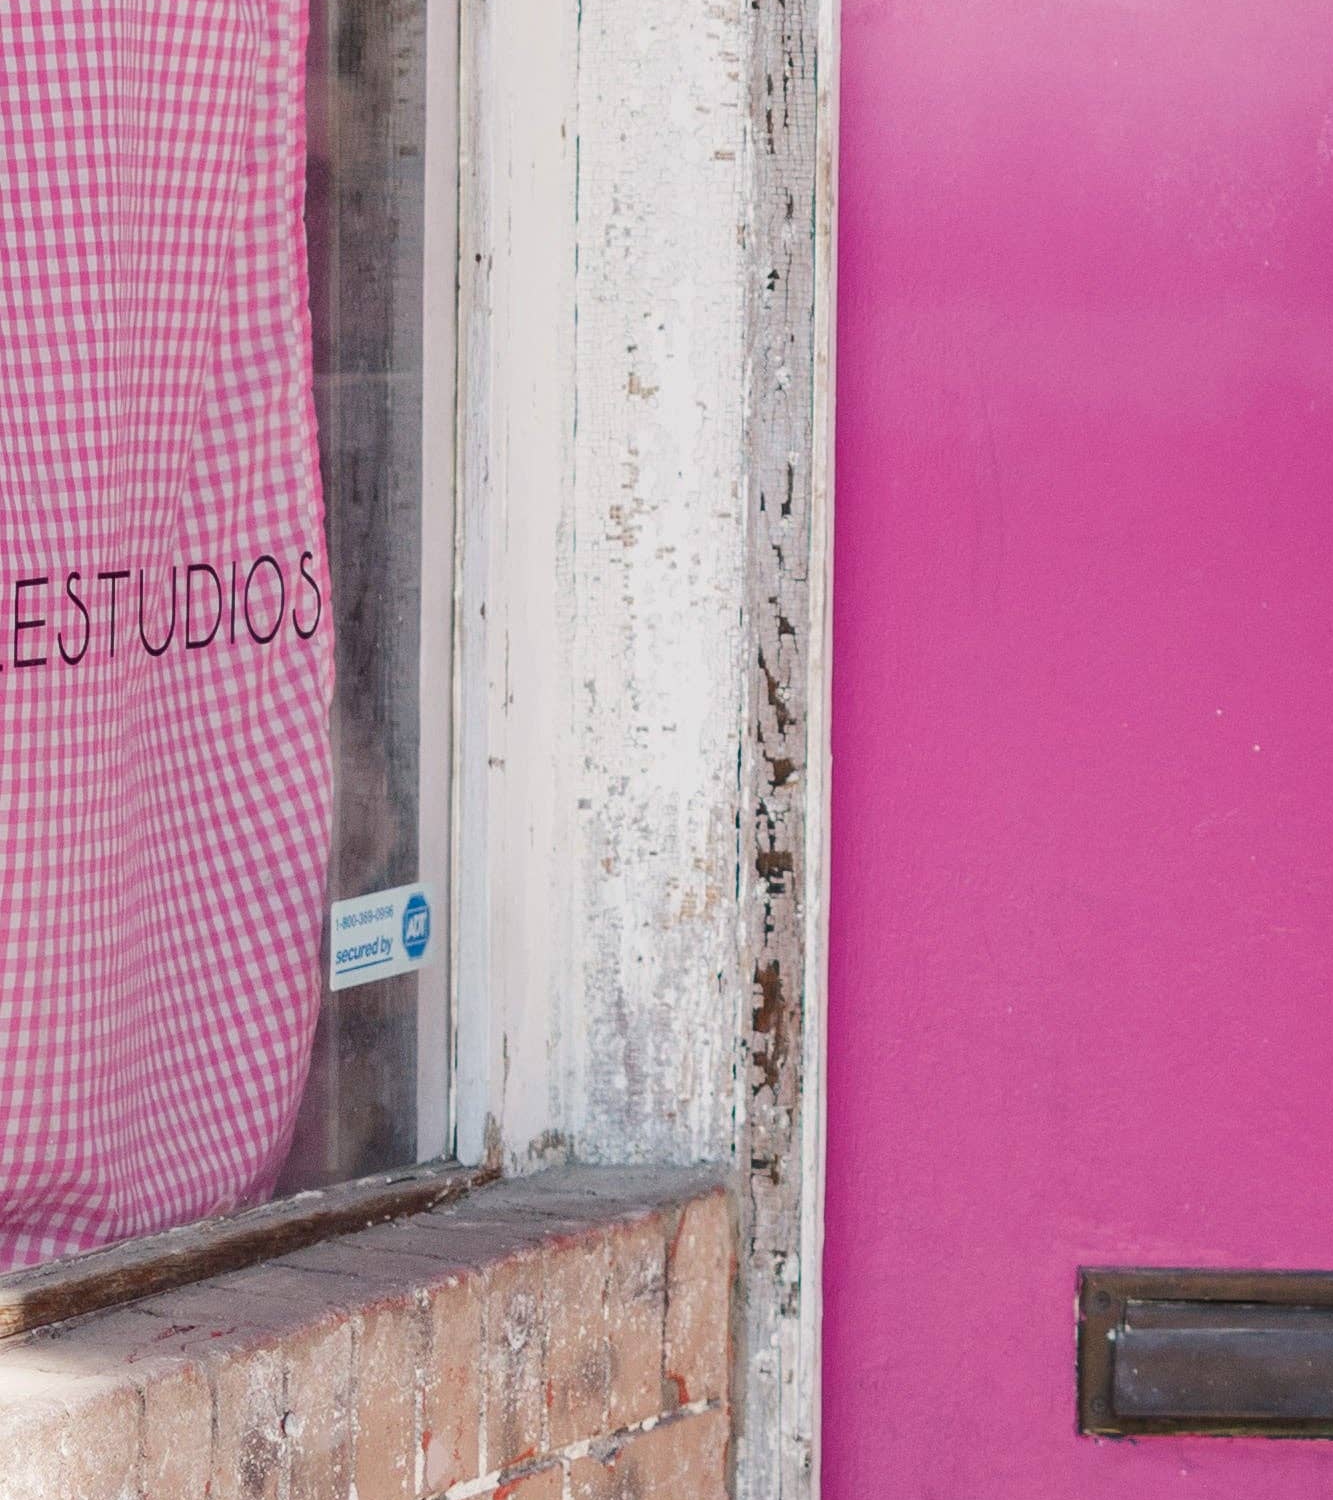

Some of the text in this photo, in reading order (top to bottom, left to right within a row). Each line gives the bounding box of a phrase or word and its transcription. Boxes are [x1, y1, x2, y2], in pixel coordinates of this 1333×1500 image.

[0, 551, 321, 673] ESTUDIOS
[336, 936, 393, 964] secured by
